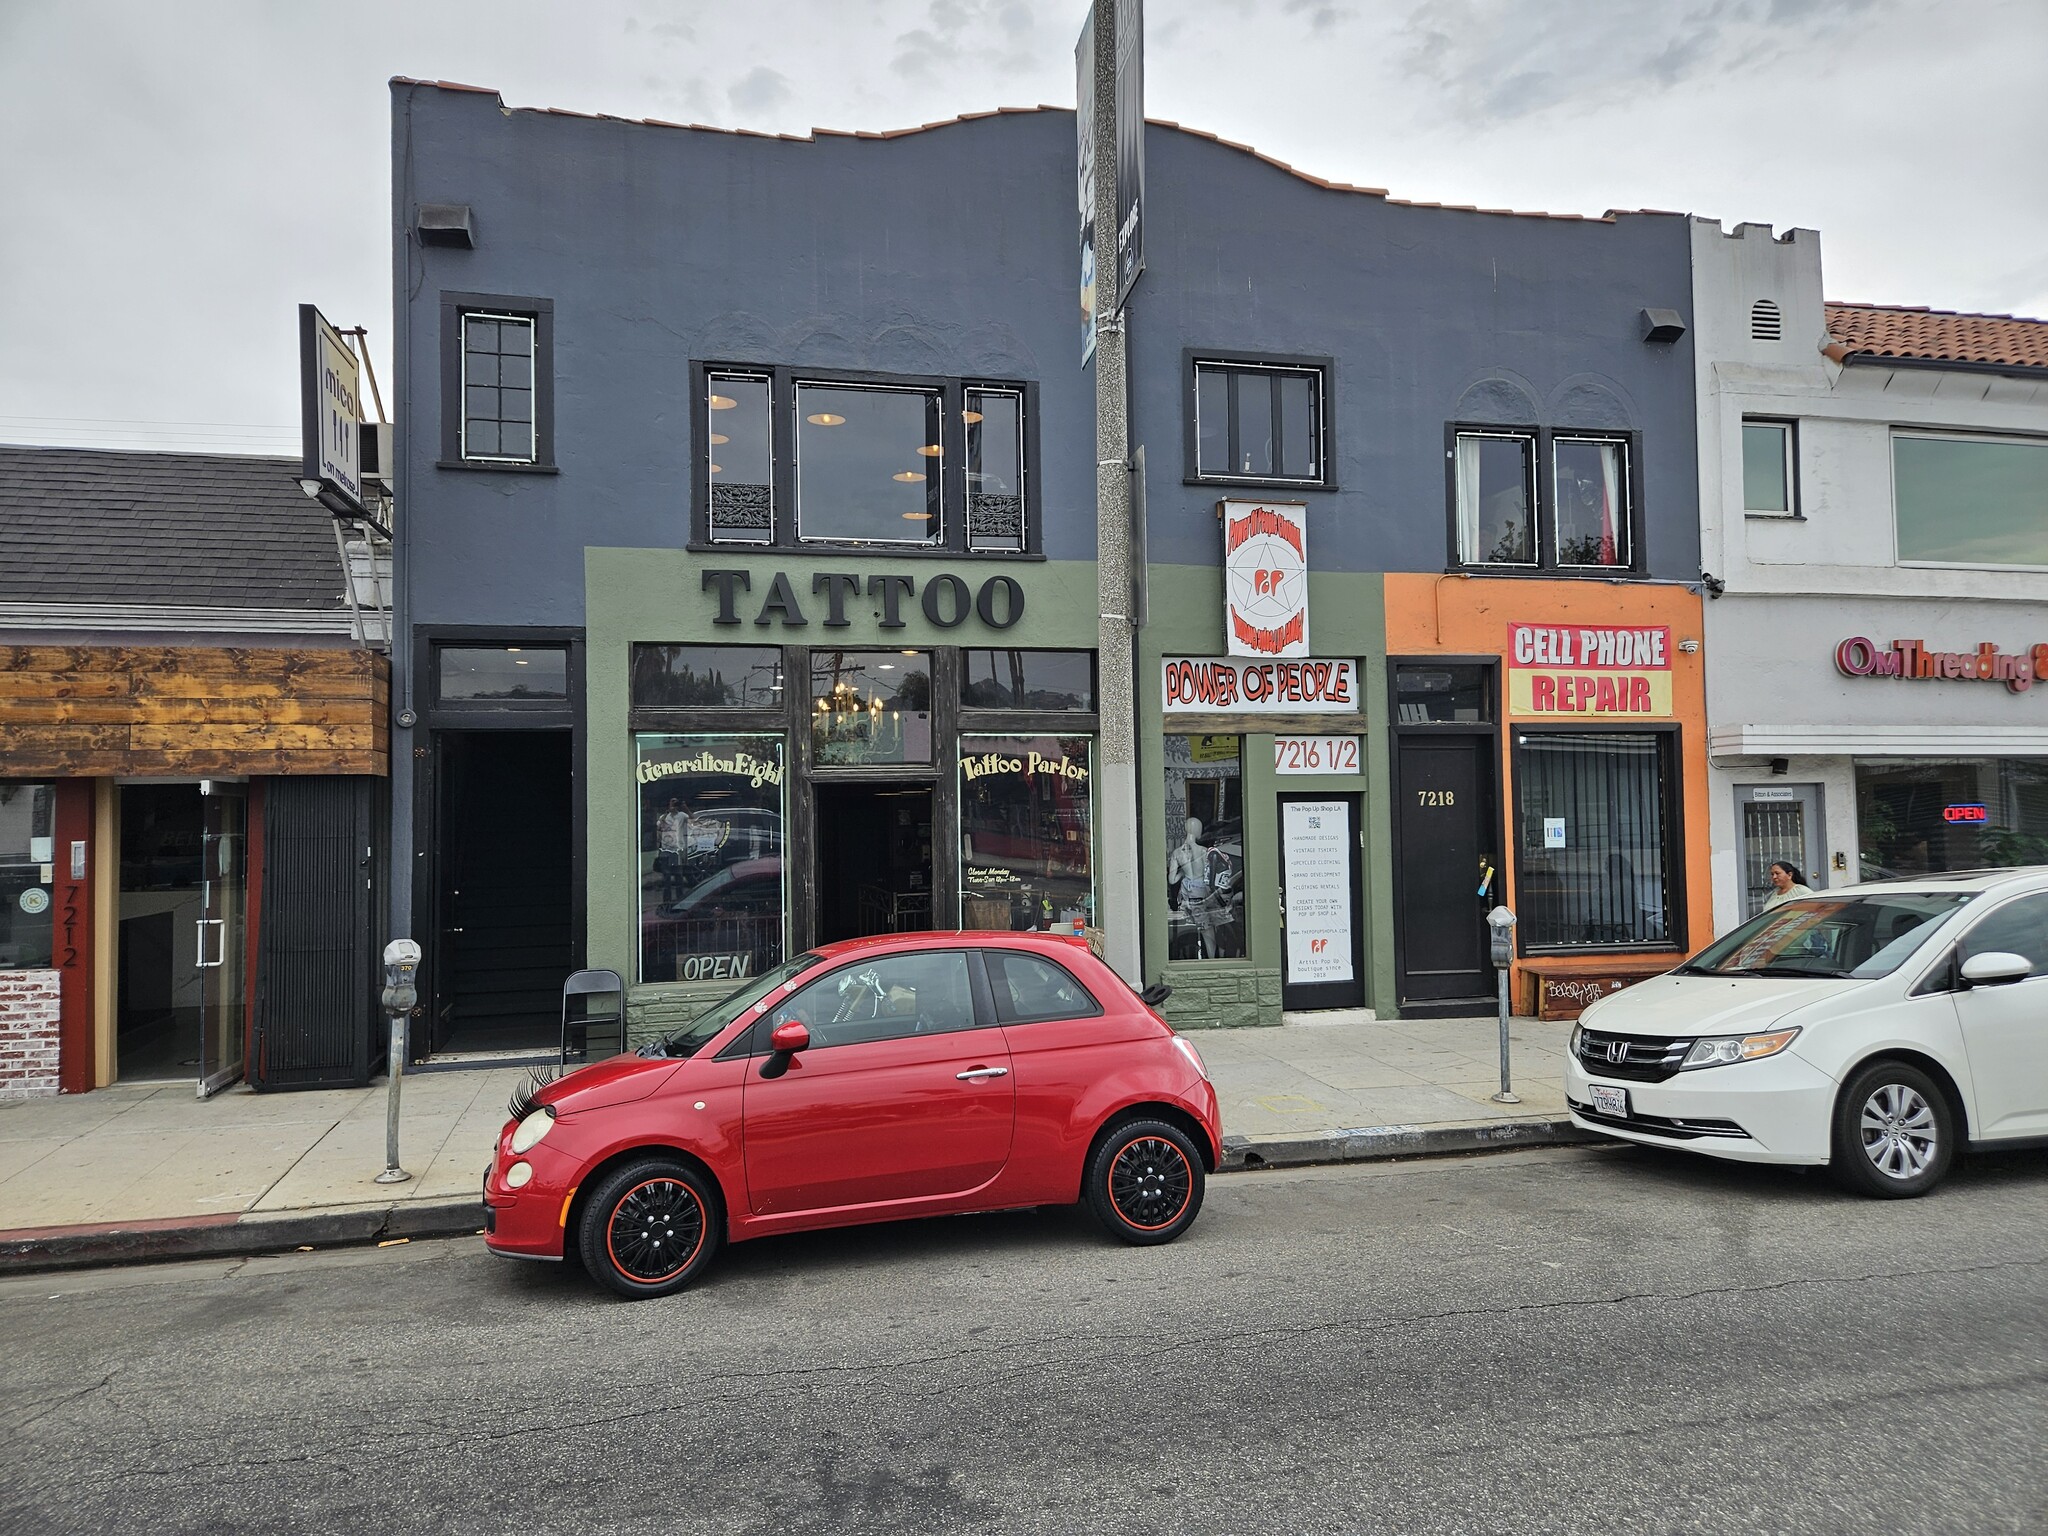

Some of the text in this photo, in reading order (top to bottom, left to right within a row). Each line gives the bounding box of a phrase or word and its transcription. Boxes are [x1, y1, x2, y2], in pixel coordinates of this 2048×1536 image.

[325, 367, 354, 417] mica
[326, 464, 335, 476] on
[701, 569, 1025, 629] TATTOO
[1514, 627, 1666, 666] CELL PHONE
[1166, 660, 1351, 706] POWER OF PEOPLE
[1531, 675, 1652, 712] REPAIR
[958, 751, 1089, 782] Tattoo Parlor
[1275, 740, 1357, 770] 7216 1/2
[1417, 791, 1455, 806] 7218
[1943, 807, 1985, 820] OPEN
[988, 867, 1010, 877] Monday
[63, 885, 78, 967] 7212
[684, 954, 749, 981] OPEN
